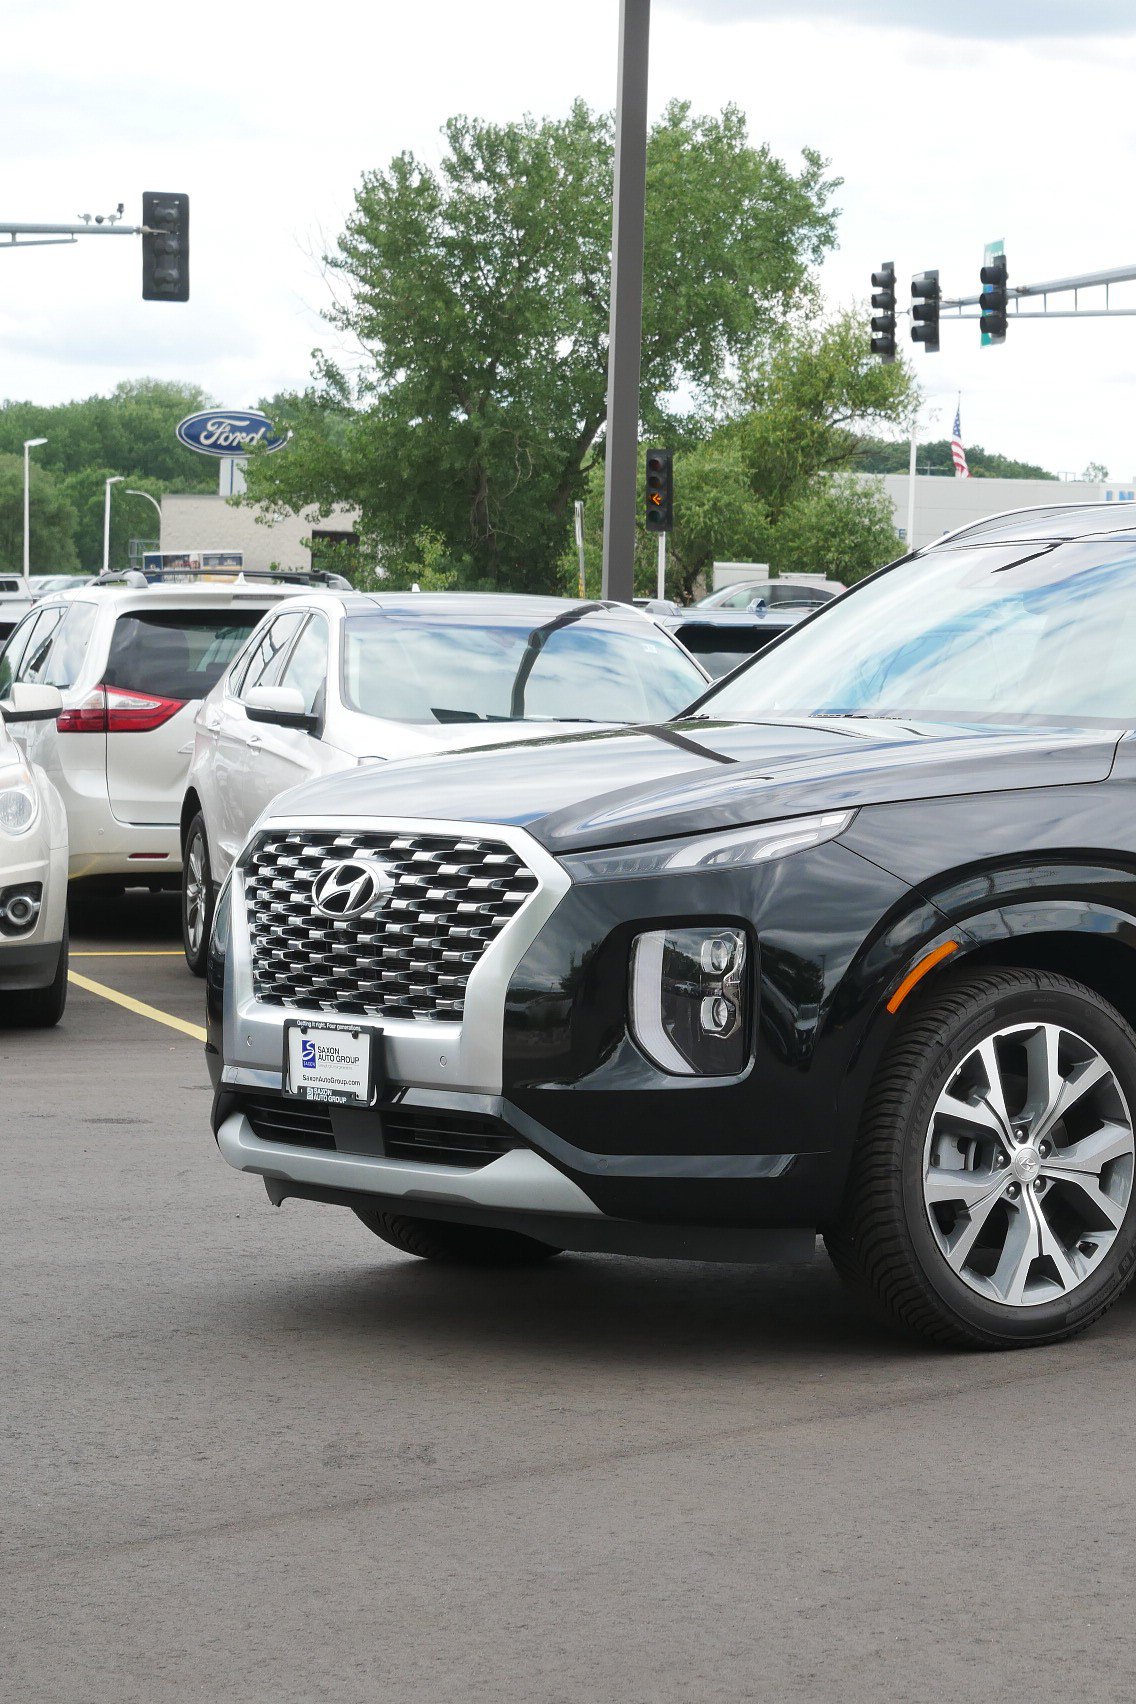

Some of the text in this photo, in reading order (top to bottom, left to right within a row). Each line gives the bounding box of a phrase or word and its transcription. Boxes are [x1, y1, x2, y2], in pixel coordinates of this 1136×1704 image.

[200, 418, 266, 447] Ford
[317, 1046, 340, 1055] SAXON
[317, 1054, 360, 1064] AUTO GROUP
[302, 1075, 361, 1086] SaxonAutoGroup.com
[313, 1088, 333, 1096] SAXON
[313, 1094, 347, 1104] AUTO GROUP
